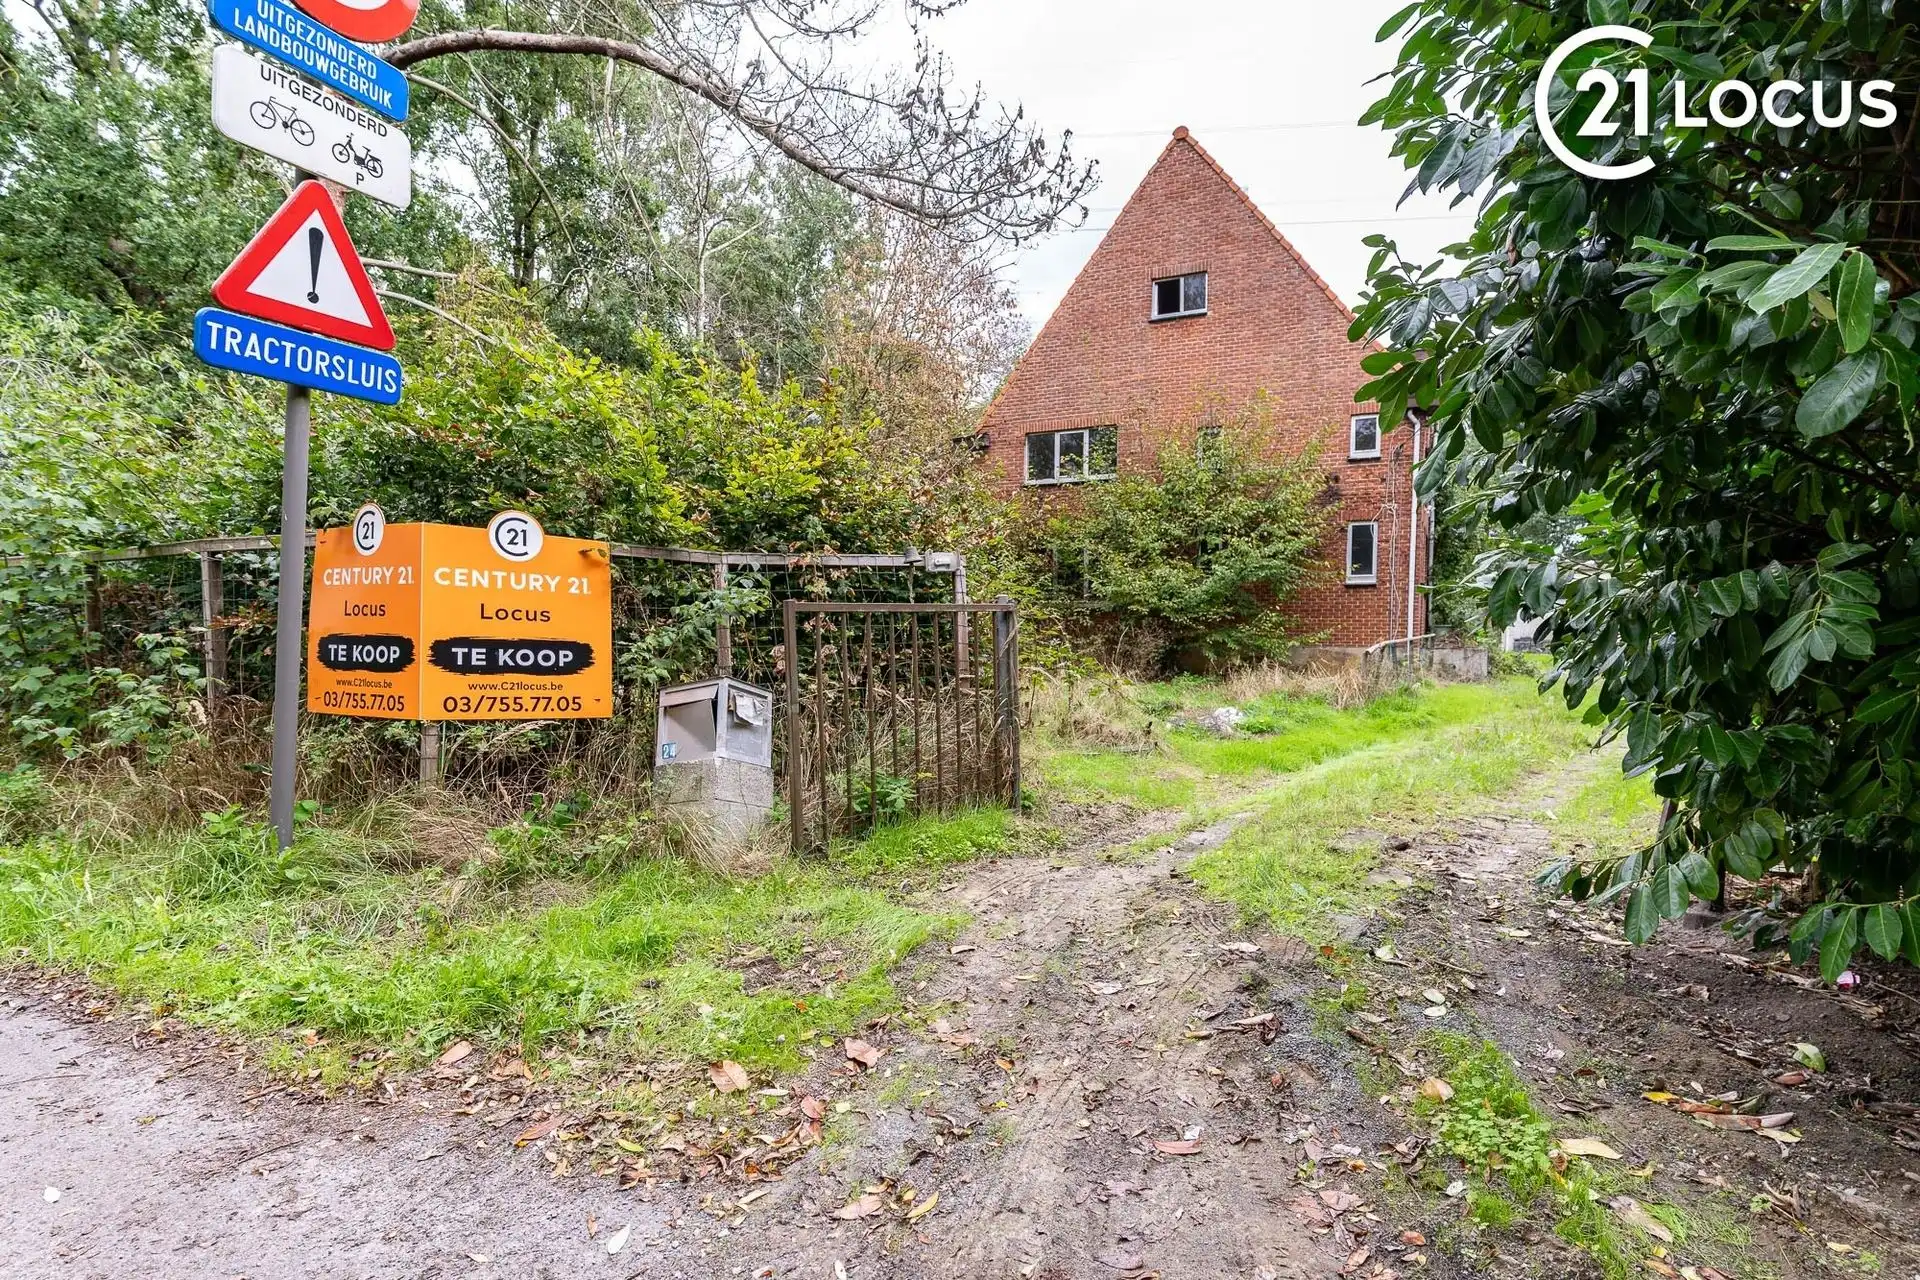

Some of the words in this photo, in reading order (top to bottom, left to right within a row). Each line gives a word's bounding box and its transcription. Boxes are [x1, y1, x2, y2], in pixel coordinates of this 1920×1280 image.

[257, 0, 377, 79] UITGEZONDERD
[234, 8, 392, 109] LANDBOUWGEBRUIK
[260, 64, 388, 137] UITGEZONDERD
[355, 172, 365, 185] P
[206, 321, 397, 393] TRACTORSLUIS
[323, 567, 394, 586] CENTURY
[433, 567, 561, 593] CENTURY
[344, 600, 386, 617] Locus
[480, 603, 551, 622] Locus
[328, 644, 347, 662] TE
[352, 644, 400, 664] KOOP
[451, 647, 486, 666] TE
[498, 648, 574, 667] KOOP
[336, 677, 393, 689] www.C21locus.be
[468, 681, 563, 691] www.C21locus.be
[323, 691, 405, 712] 03/755.77.05
[443, 695, 582, 713] 03/755.77.05
